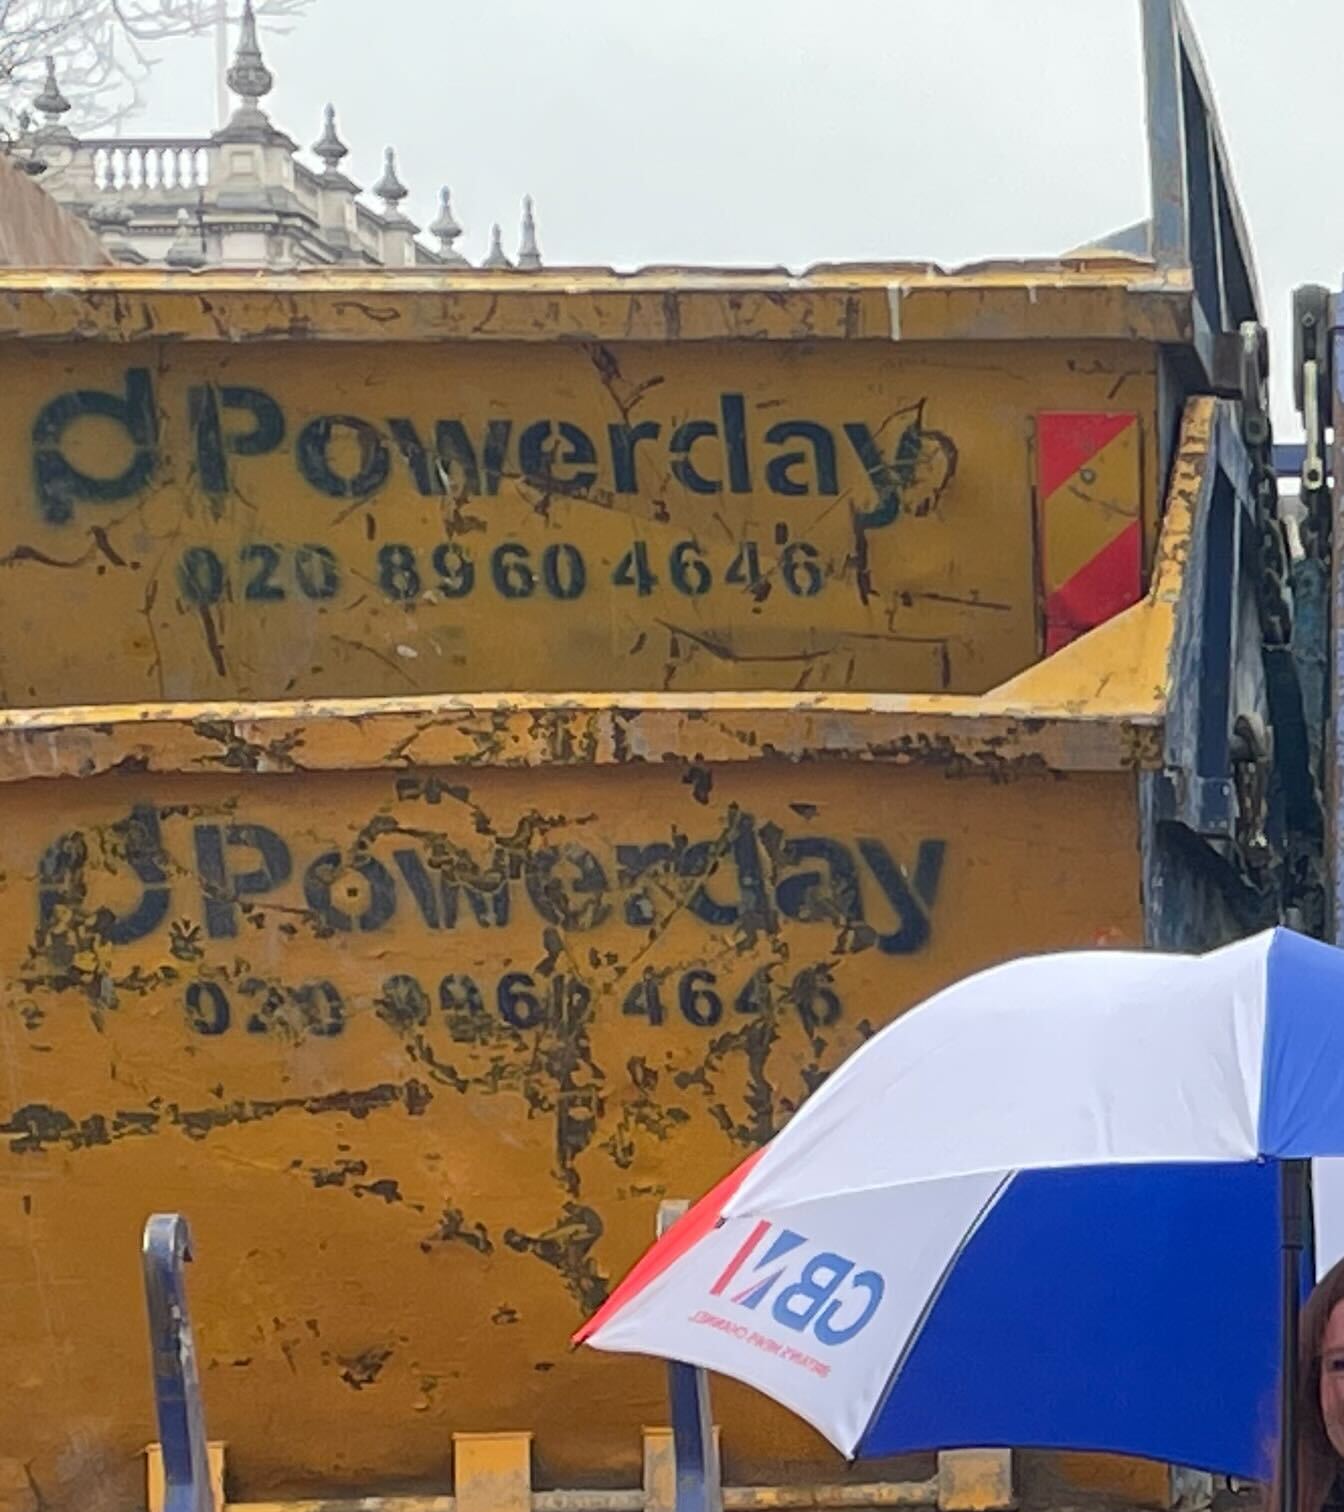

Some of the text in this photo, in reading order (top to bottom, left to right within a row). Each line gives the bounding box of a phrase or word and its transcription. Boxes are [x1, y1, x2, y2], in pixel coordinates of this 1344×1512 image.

[187, 385, 925, 530] Powerday
[179, 540, 826, 603] 020 8960 4646
[193, 808, 947, 955] Powerday
